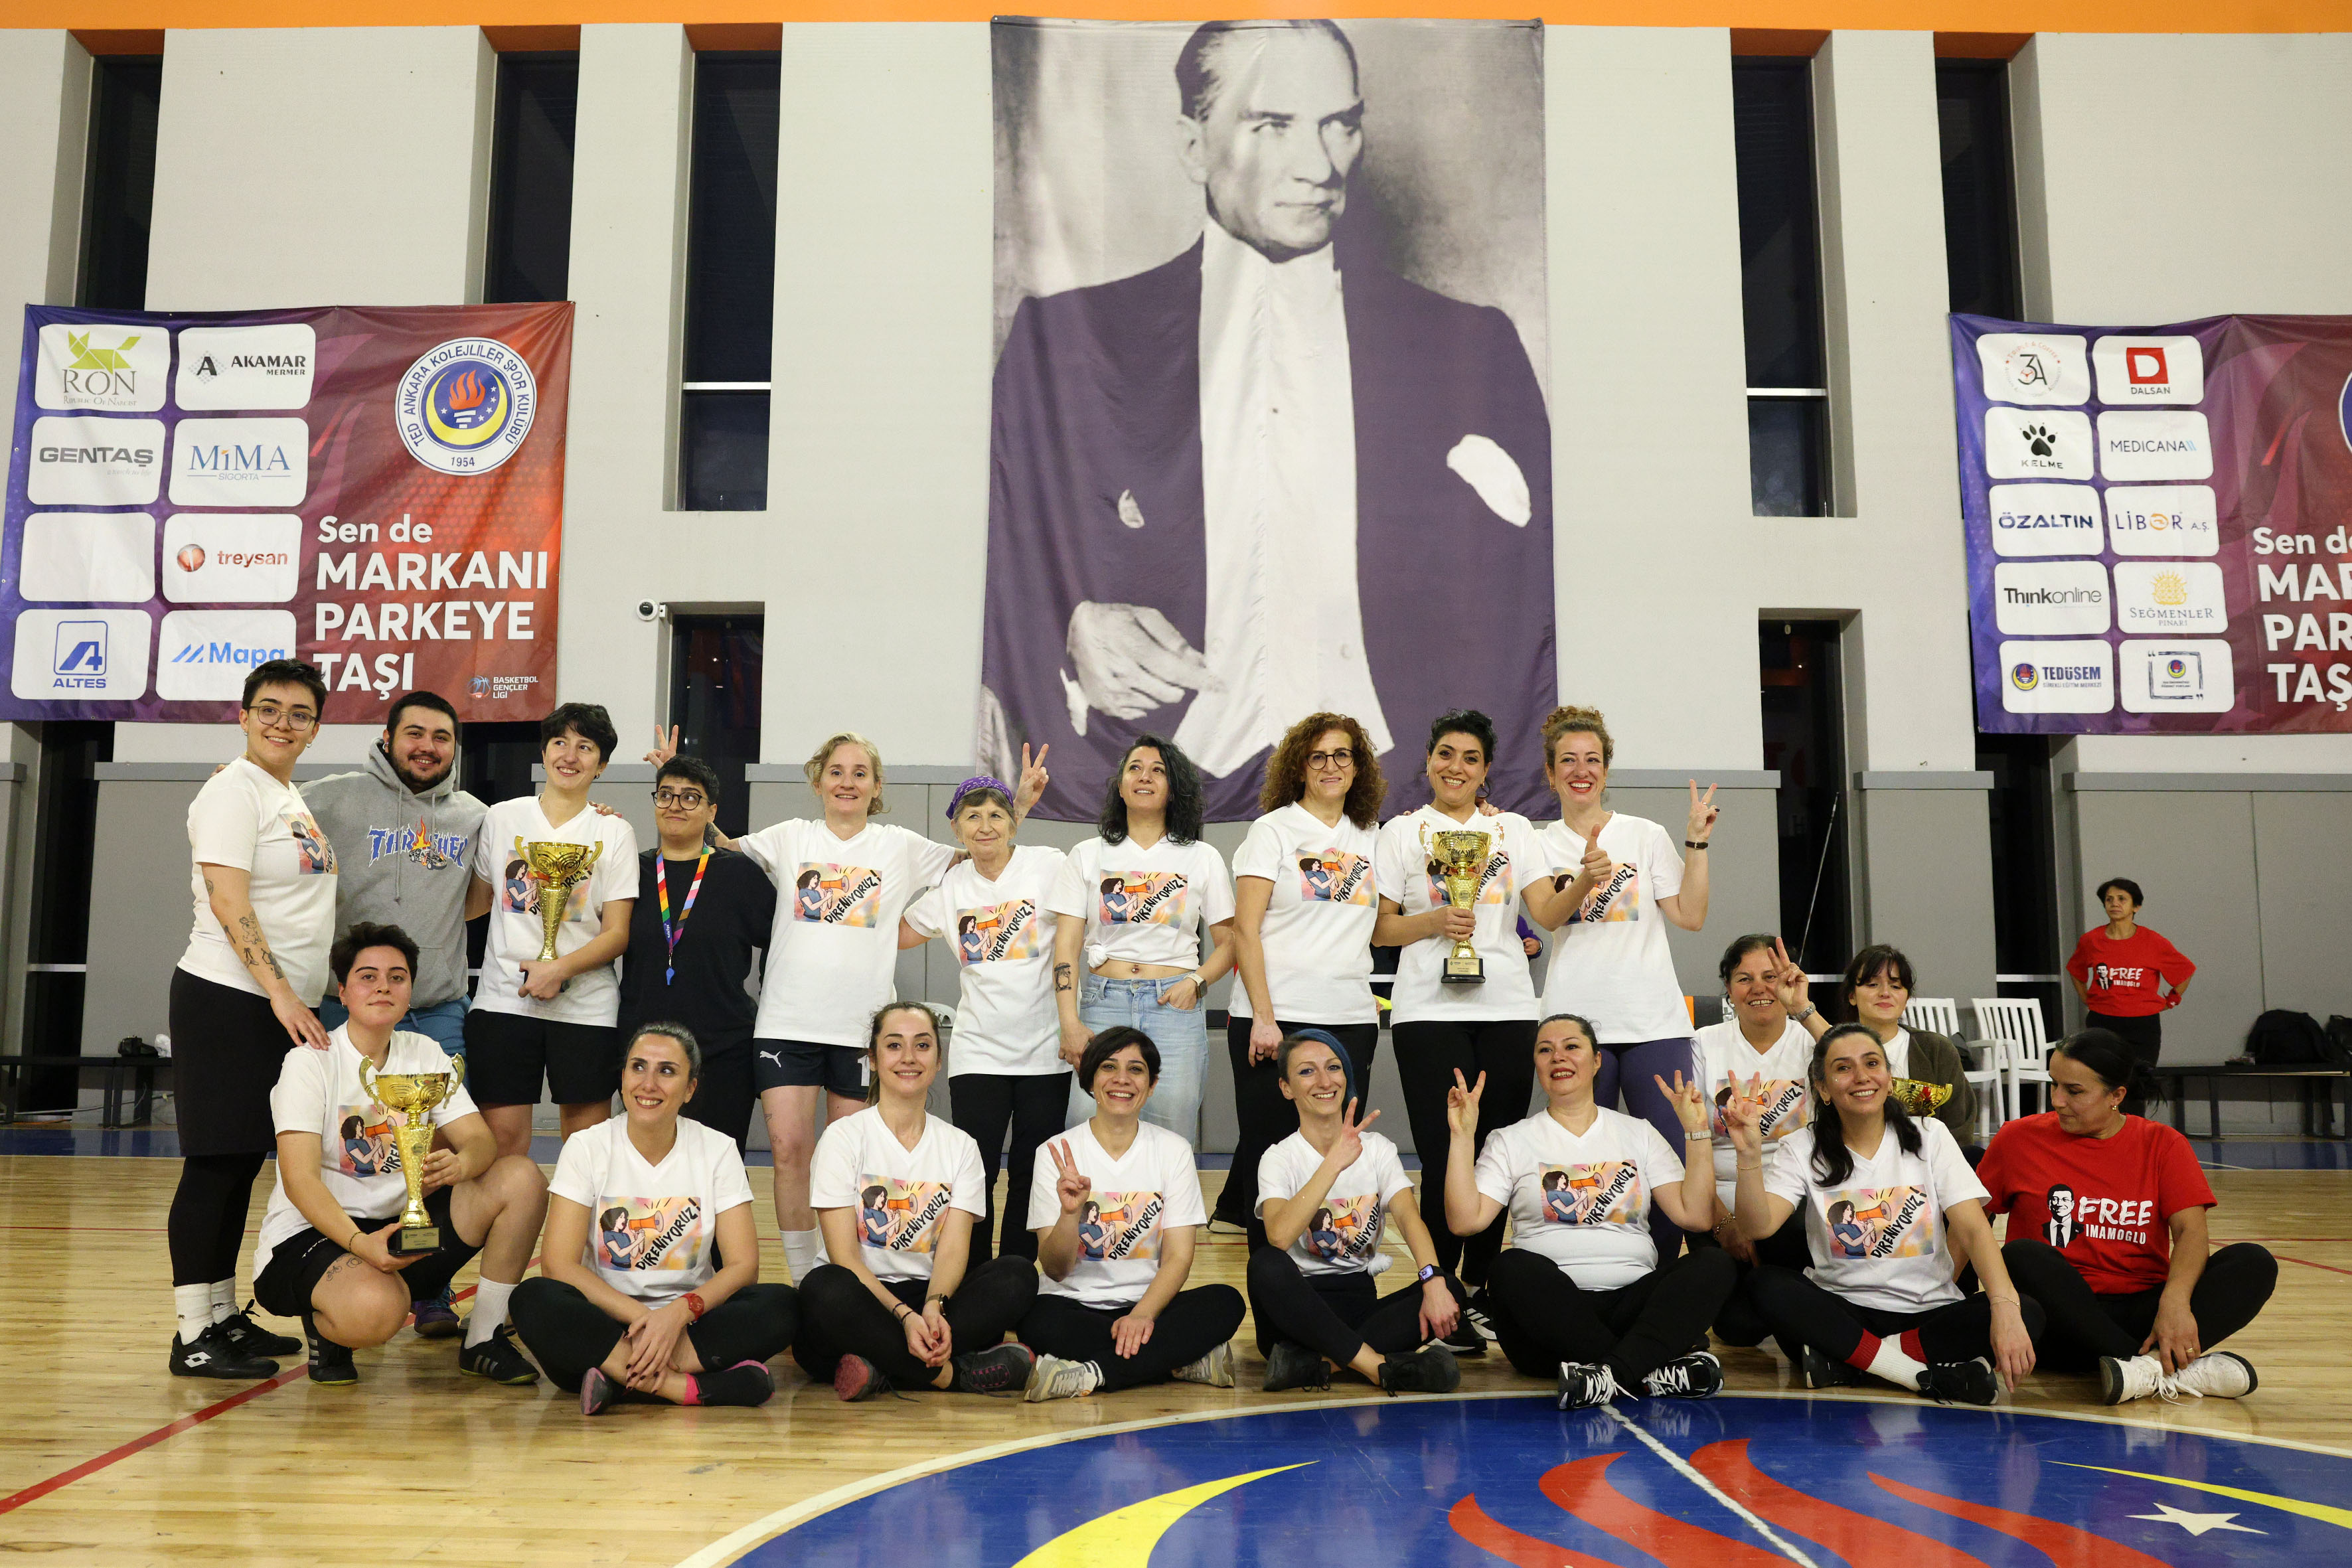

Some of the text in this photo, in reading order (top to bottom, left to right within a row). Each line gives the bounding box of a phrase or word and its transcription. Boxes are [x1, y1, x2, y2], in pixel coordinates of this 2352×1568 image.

[231, 355, 306, 368] AKAMAR
[62, 368, 137, 396] RON
[404, 342, 530, 447] TED ANKARA KOLEJLİLER SPOR KULÜBÜ
[2110, 440, 2189, 453] MEDICANA
[39, 446, 154, 467] GENTAŞ
[451, 456, 475, 467] 1954
[2021, 459, 2063, 469] KELME
[317, 513, 433, 544] Sen de
[1998, 511, 2094, 529] ÖZALTIN
[2252, 524, 2352, 555] Sen d
[217, 550, 288, 568] treysan
[316, 550, 548, 591] MARKANI
[2003, 587, 2102, 605] Thinkonline
[315, 601, 534, 641] PARKEYE
[2130, 607, 2215, 619] SEĞMENLER
[209, 642, 285, 668] Mapa
[52, 677, 107, 688] ALTES
[313, 652, 415, 701] TAŞI
[493, 684, 528, 692] GENÇLER
[2108, 967, 2144, 980] FREE
[2077, 1196, 2154, 1227] FREE
[2085, 1223, 2147, 1245] IMAMOGLU
